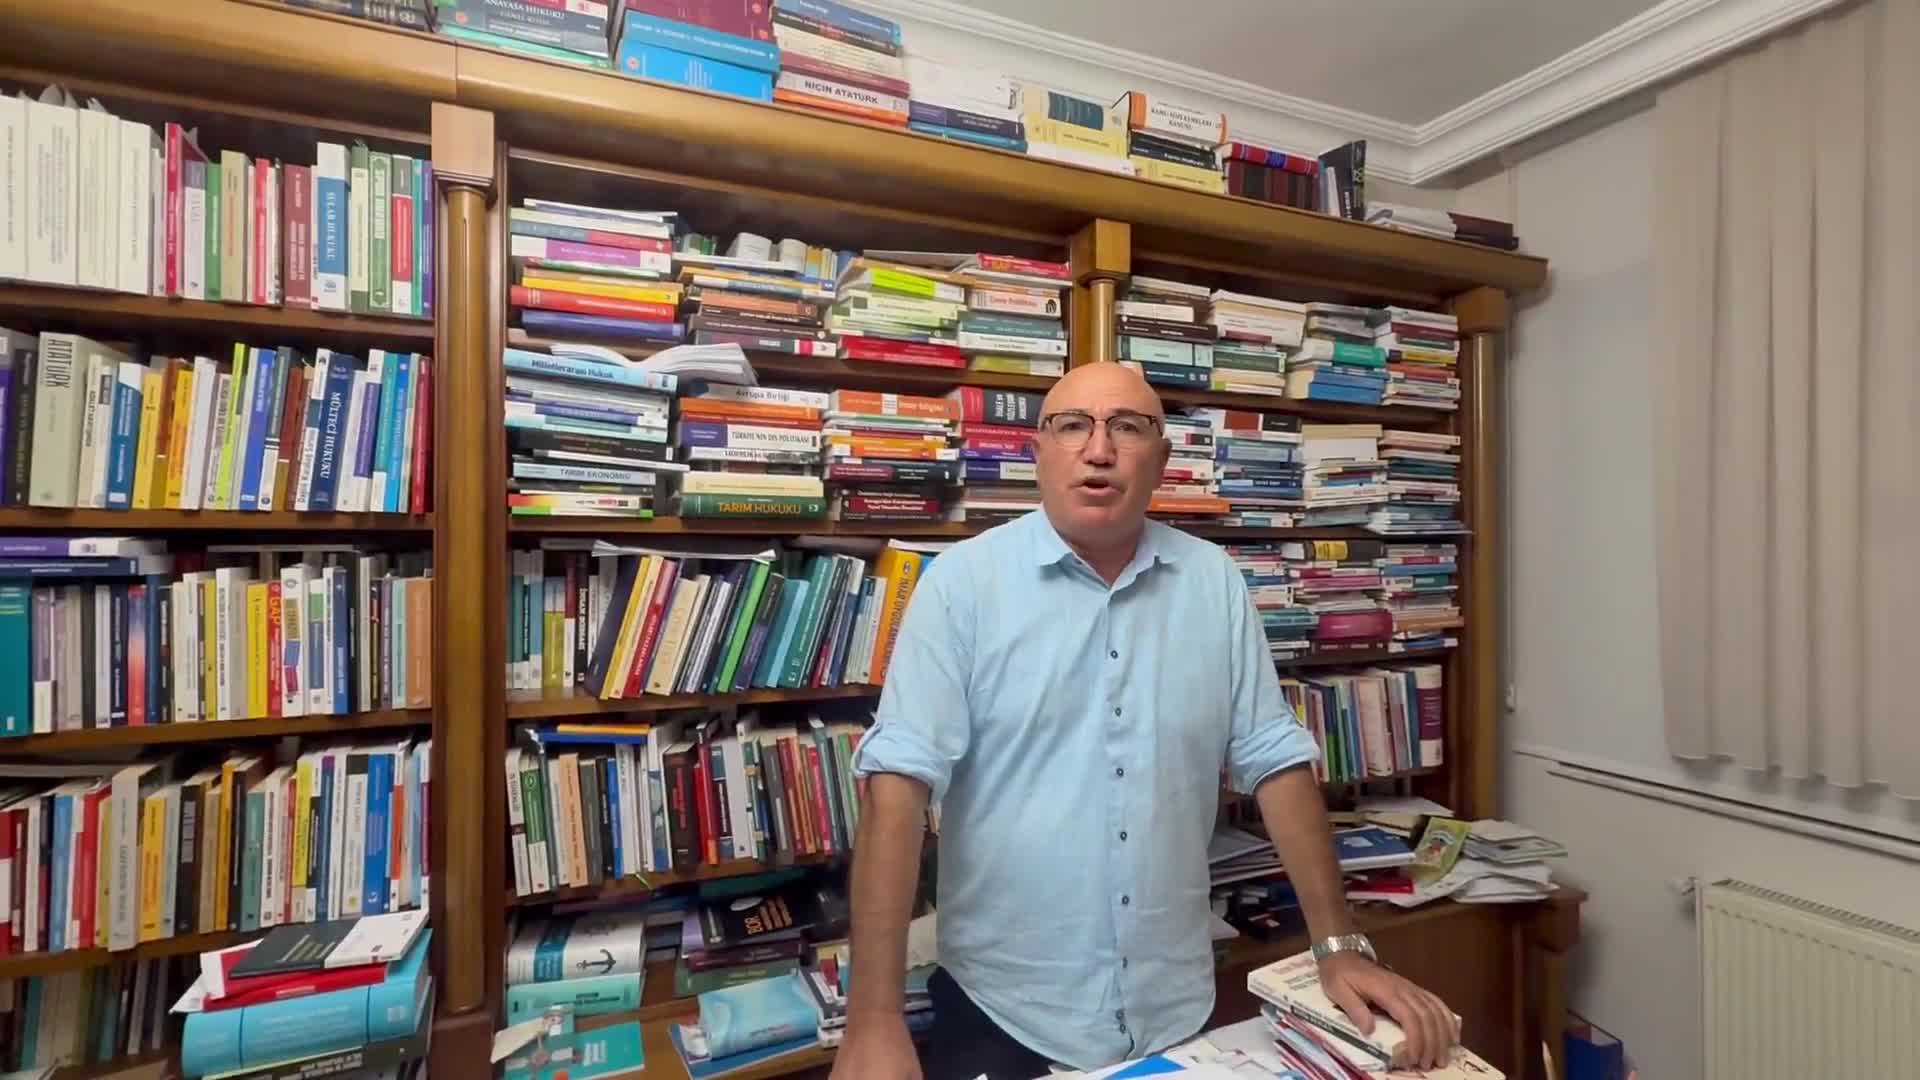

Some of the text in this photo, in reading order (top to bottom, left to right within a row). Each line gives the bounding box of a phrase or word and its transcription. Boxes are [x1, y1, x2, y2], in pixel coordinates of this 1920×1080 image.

[526, 5, 566, 20] HUKUKU
[45, 338, 73, 389] ATATÜRK
[320, 392, 342, 479] MÜLTECİ HUKUKU
[719, 501, 801, 514] TARIM HUKUKU
[269, 596, 282, 625] GAP
